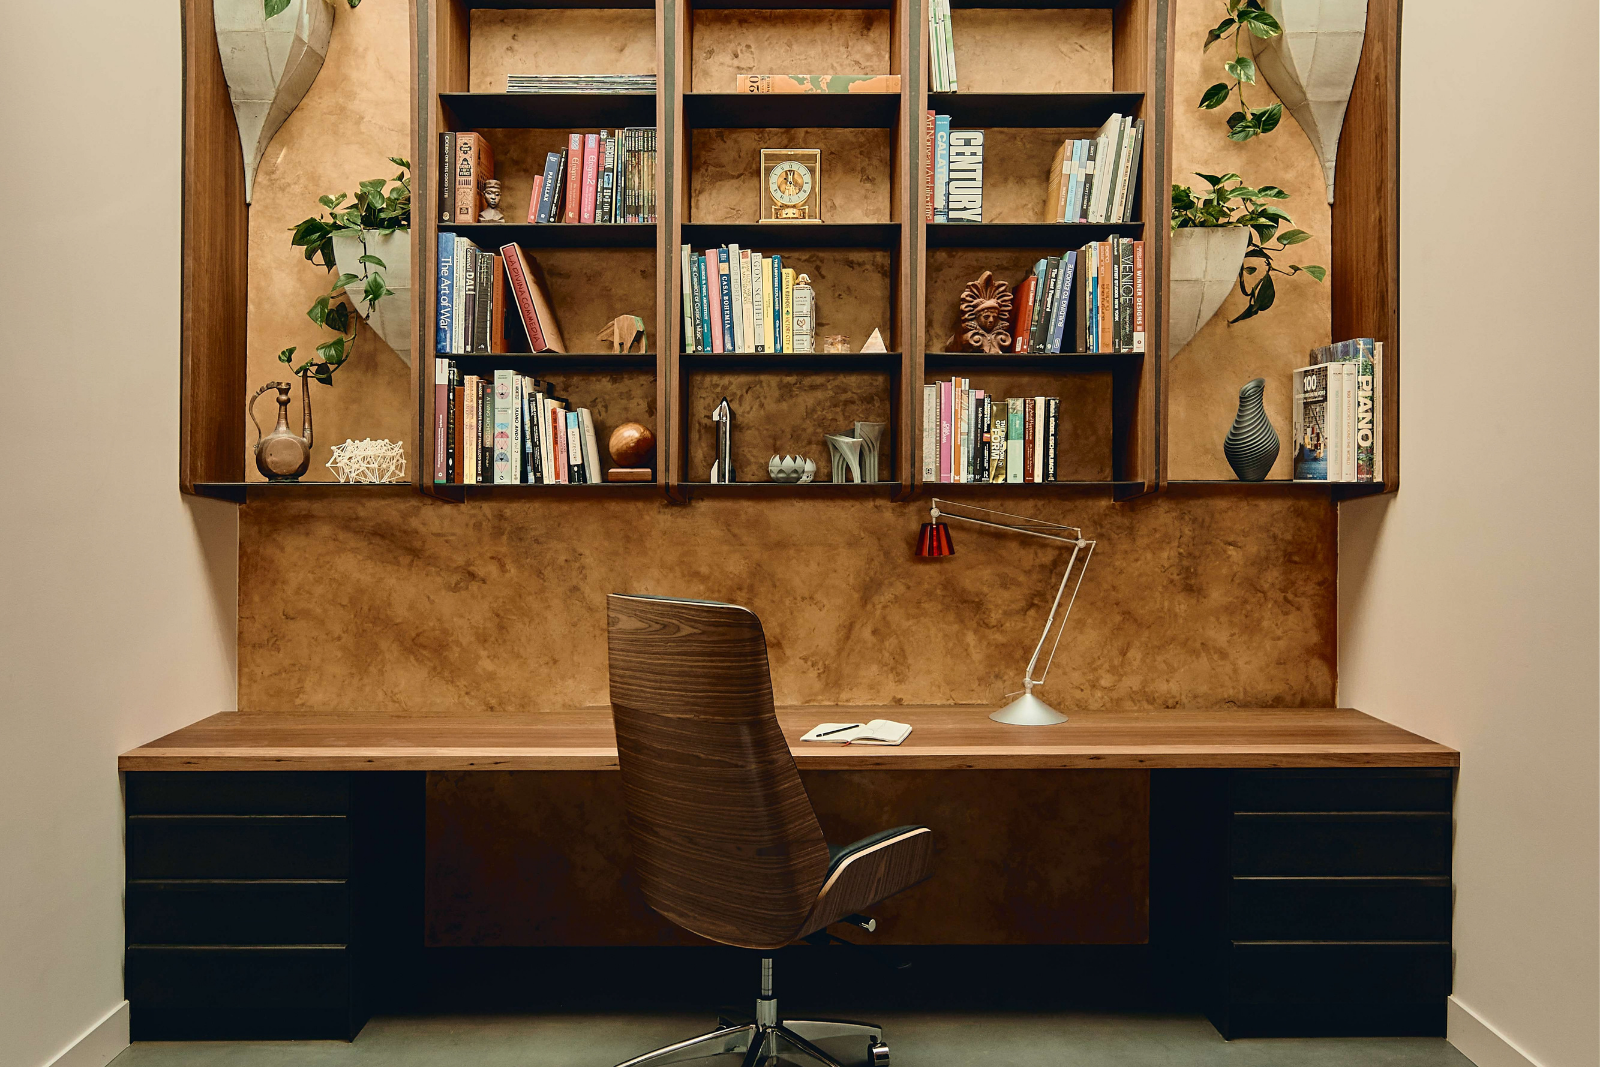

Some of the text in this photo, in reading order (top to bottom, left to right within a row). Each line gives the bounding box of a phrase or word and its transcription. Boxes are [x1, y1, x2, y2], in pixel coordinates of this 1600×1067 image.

[748, 76, 760, 92] 20
[586, 155, 596, 179] Enigma
[605, 139, 615, 168] LOGICOMIX
[926, 114, 934, 220] Art Nouveau Architecture
[569, 157, 579, 181] Enigma
[948, 132, 984, 222] CENTURY
[543, 171, 553, 202] PARALLAX
[753, 254, 761, 282] EGON
[1064, 264, 1073, 290] EDUCATE
[1121, 255, 1134, 304] VENICE
[440, 256, 452, 329] The Art of War
[508, 255, 541, 342] LA DIVINA COMMEDIA
[1046, 290, 1055, 311] Vanguard
[1063, 291, 1068, 299] TO
[1058, 301, 1067, 327] BUILDING
[1304, 375, 1316, 391] 100
[1358, 375, 1372, 447] PIANO
[992, 420, 1000, 459] OF FORM
